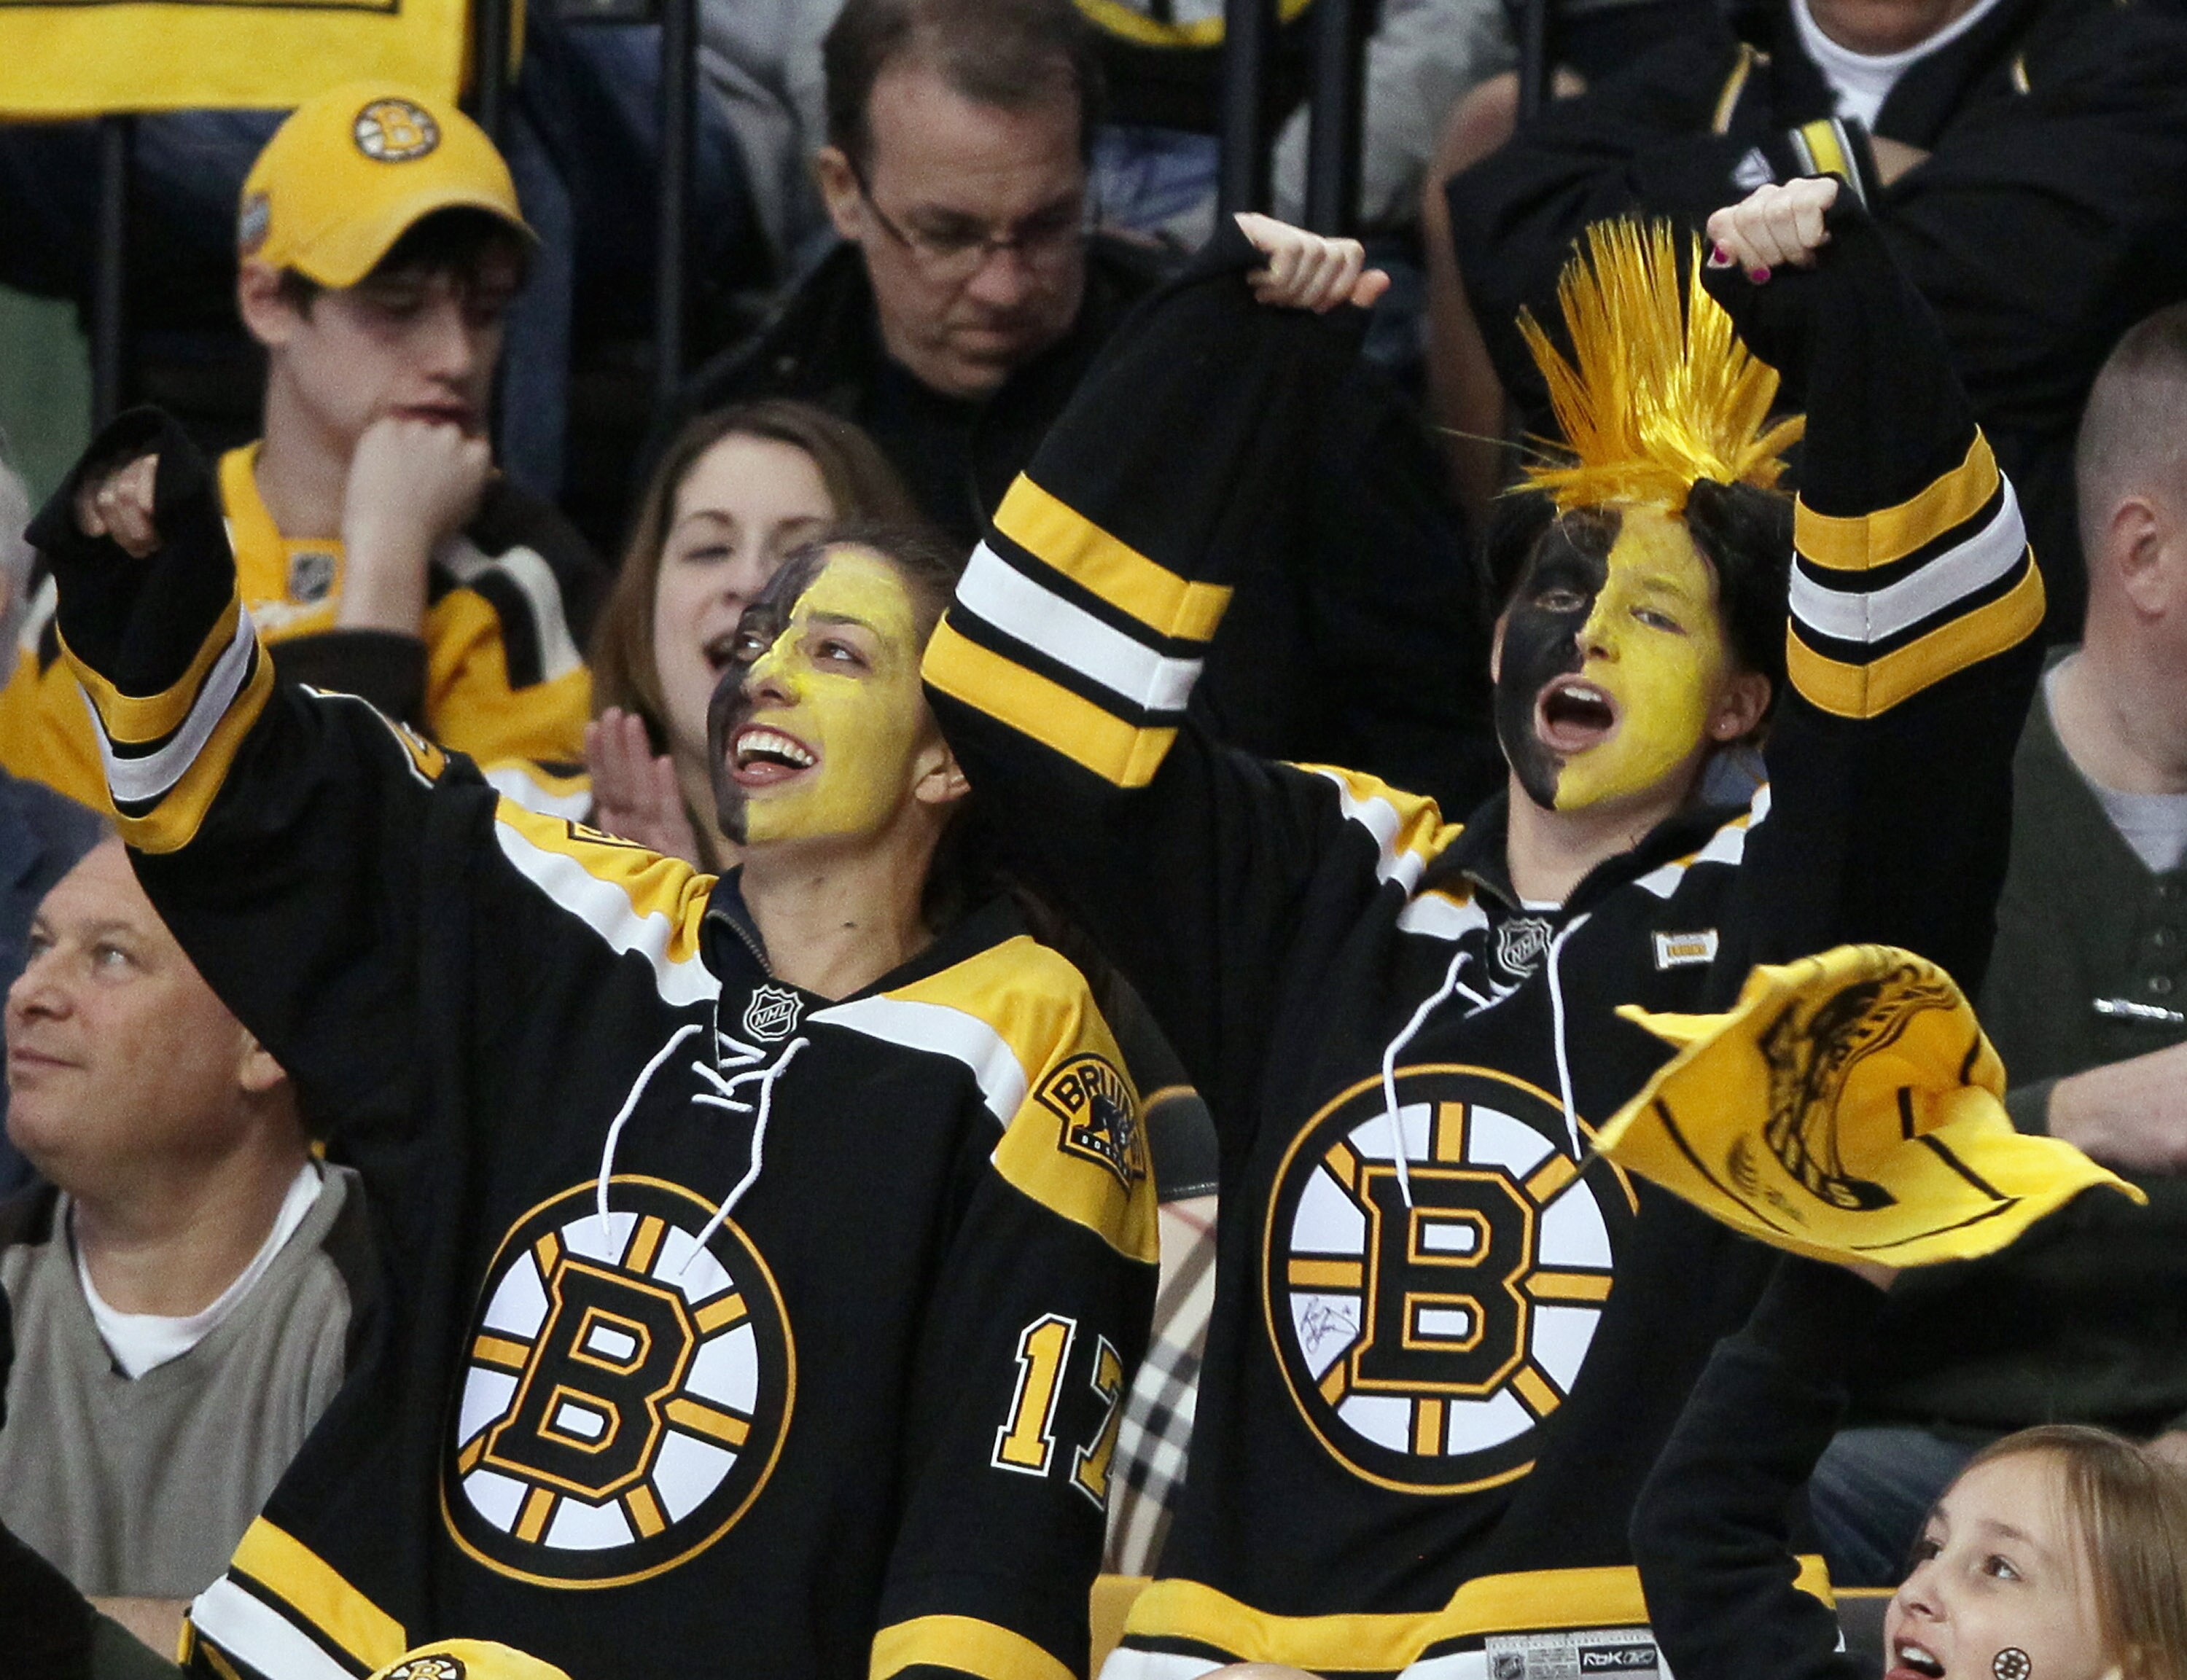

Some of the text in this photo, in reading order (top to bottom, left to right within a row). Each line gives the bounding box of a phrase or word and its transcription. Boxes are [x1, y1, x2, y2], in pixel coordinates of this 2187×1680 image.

[754, 1004, 790, 1026] NHL
[483, 1257, 695, 1499] B
[1351, 1165, 1535, 1394] B
